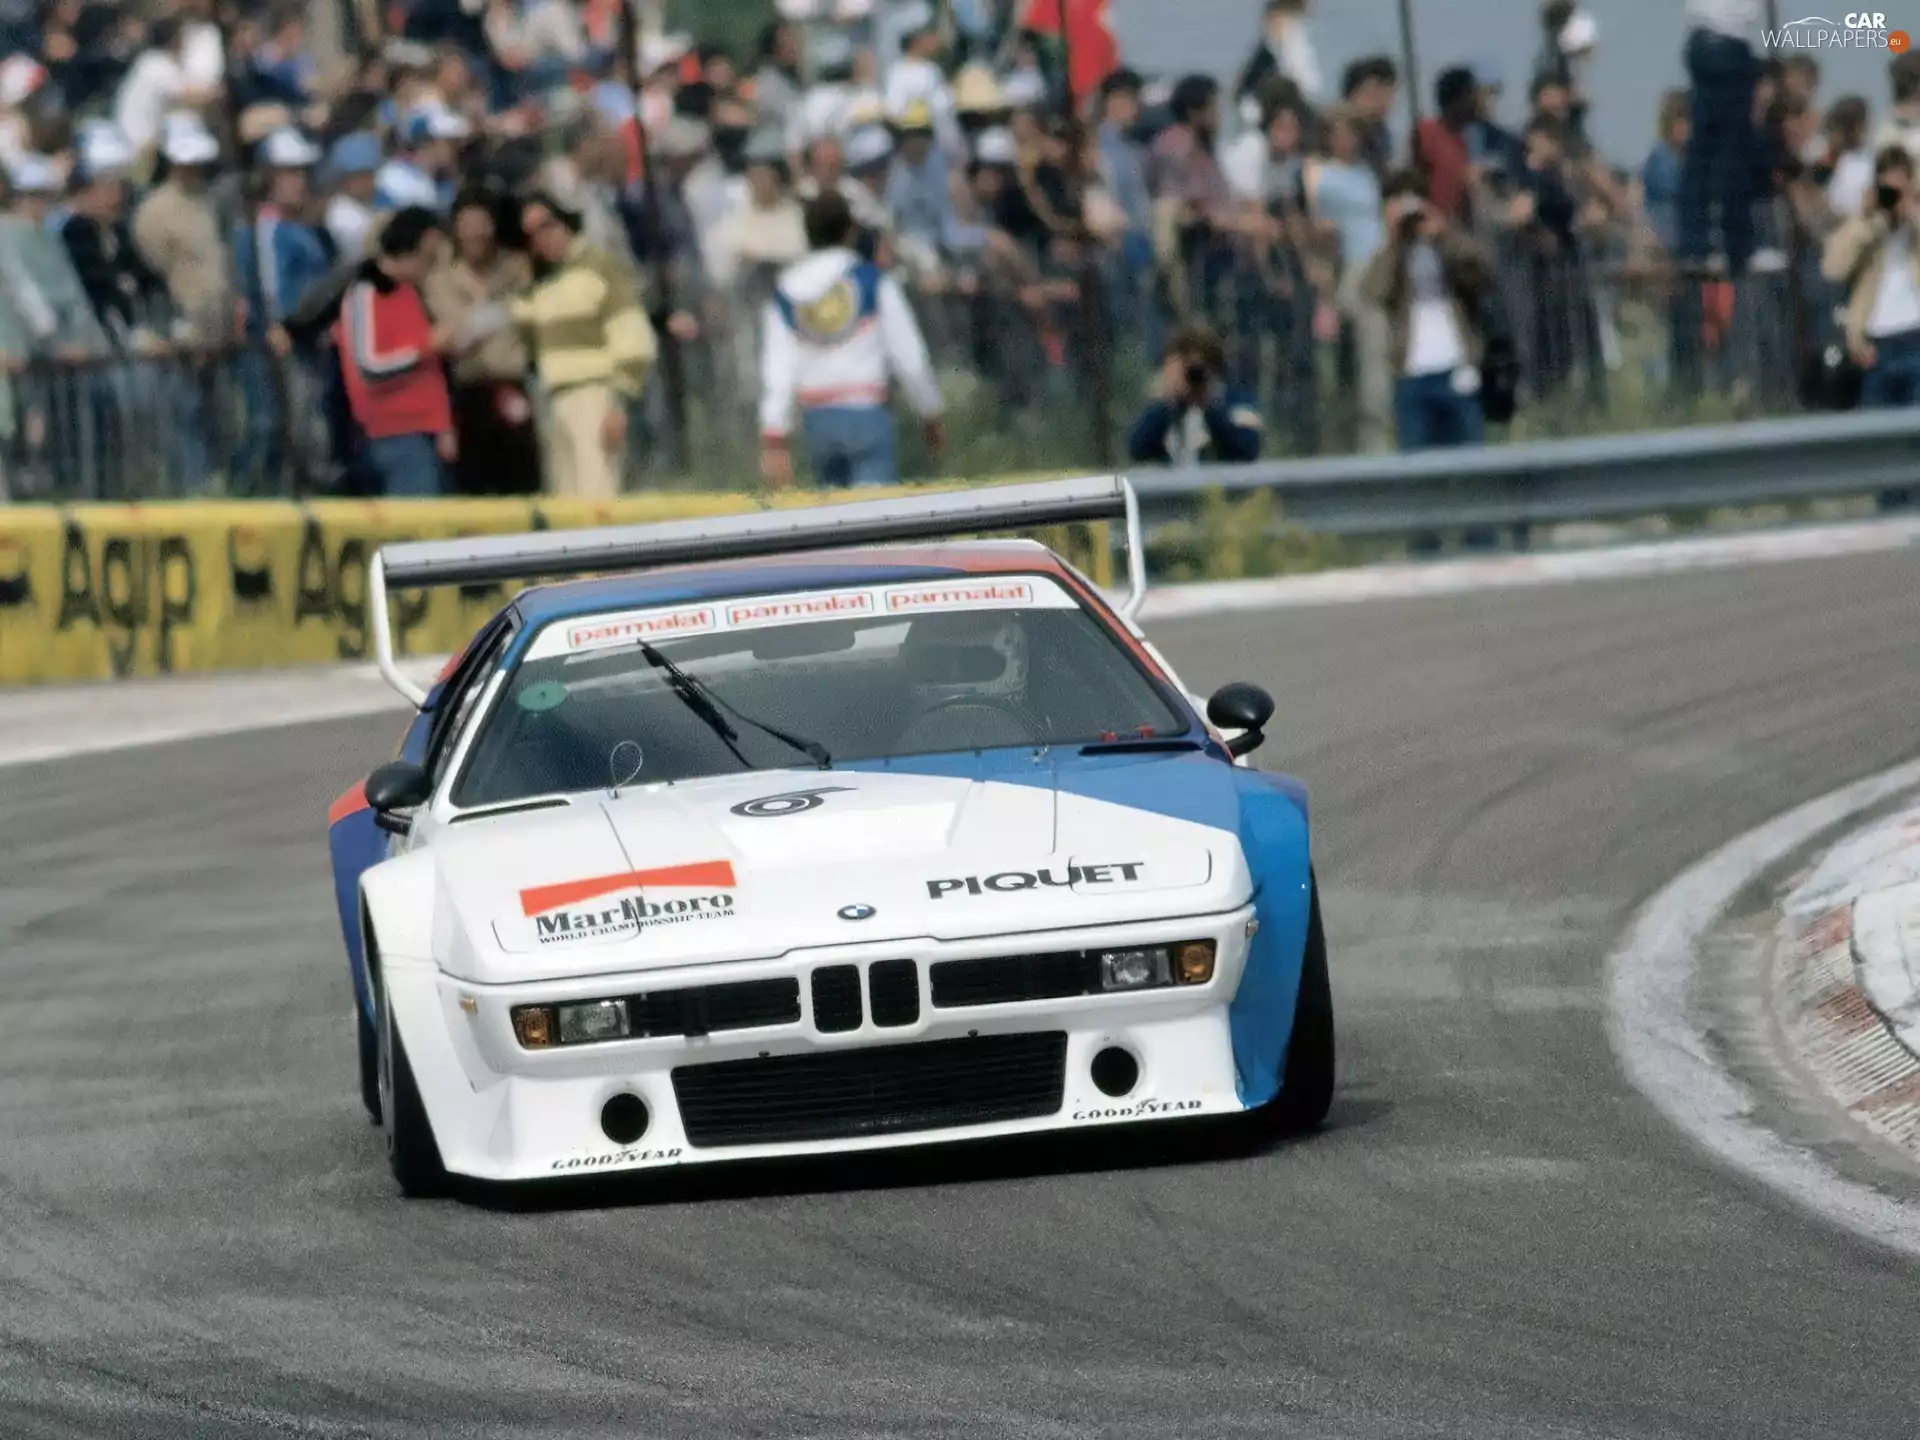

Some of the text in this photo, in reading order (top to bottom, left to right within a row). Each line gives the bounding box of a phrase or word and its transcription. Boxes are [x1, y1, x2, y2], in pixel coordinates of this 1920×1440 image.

[731, 594, 869, 624] parmalat
[890, 584, 1025, 609] parmalat
[573, 610, 708, 645] parmalat
[926, 861, 1144, 900] PIQUET
[536, 893, 734, 936] Marlboro
[1073, 1098, 1202, 1120] GOODYEAR
[551, 1147, 682, 1170] GOODYEAR
